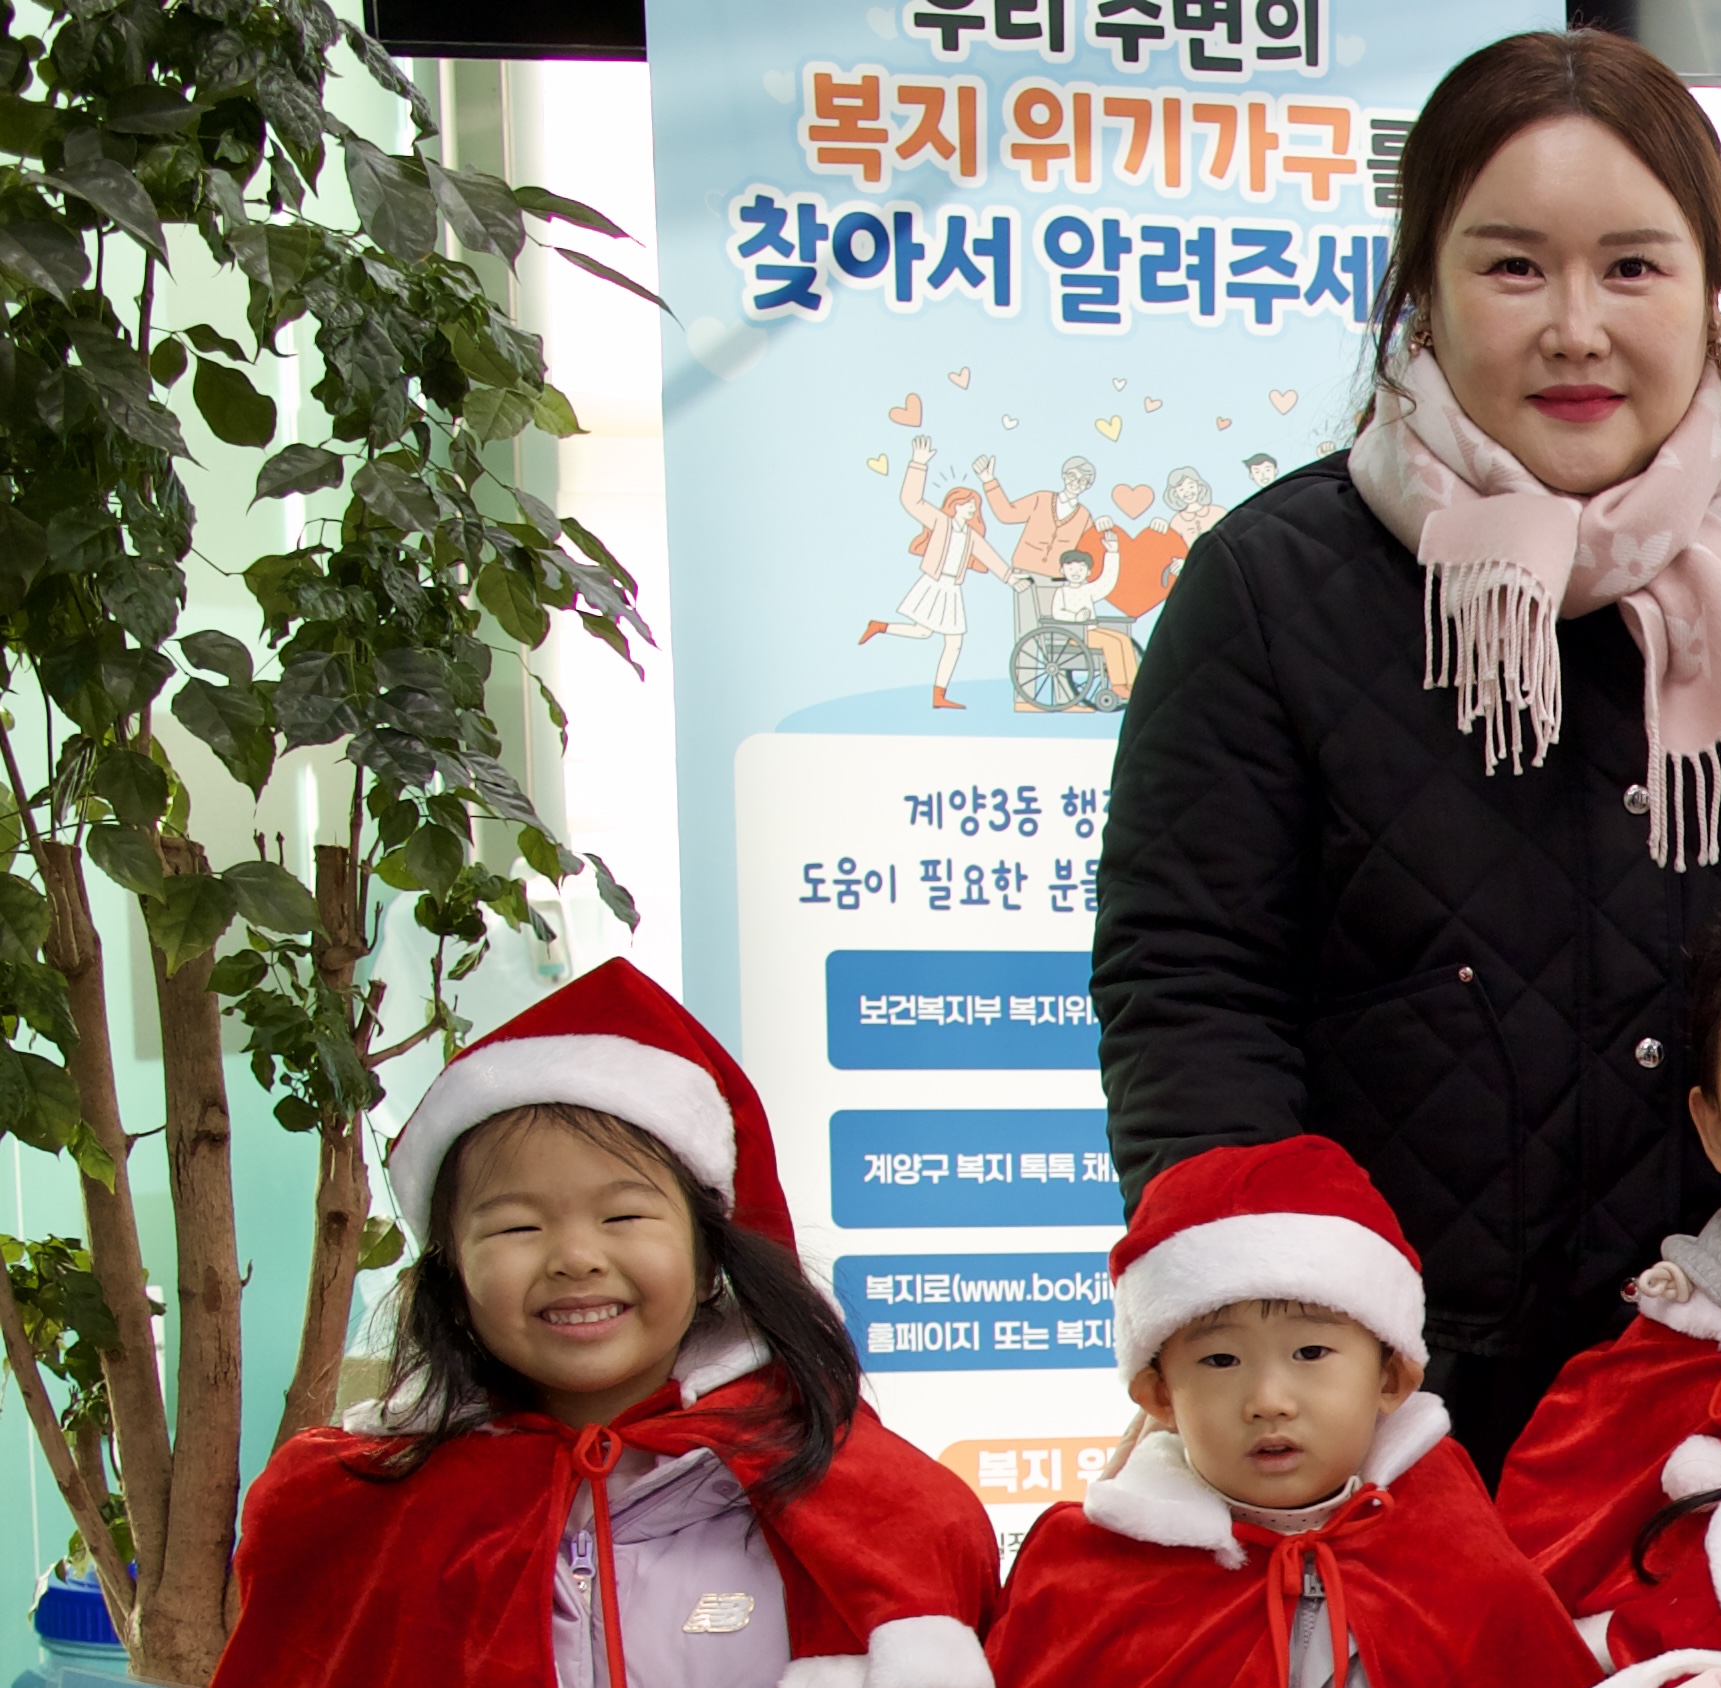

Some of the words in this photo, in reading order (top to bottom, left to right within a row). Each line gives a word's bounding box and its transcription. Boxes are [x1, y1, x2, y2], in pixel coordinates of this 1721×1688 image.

[912, 0, 1066, 54] 우리
[1094, 0, 1320, 72] 주변의
[808, 72, 979, 183] 복지
[736, 196, 1012, 312] 찾아서
[1042, 214, 1396, 326] 알려주세
[903, 785, 1043, 837] 계양3동
[799, 857, 896, 910] 도움이
[919, 858, 1028, 911] 필요한
[859, 995, 1001, 1025] 보건복지부
[1009, 995, 1101, 1025] 복지위
[863, 1153, 950, 1184] 계양구
[956, 1153, 1013, 1183] 복지
[1020, 1153, 1076, 1183] 톡톡
[867, 1321, 981, 1354] 홈페이지
[994, 1320, 1049, 1351] 또는
[978, 1448, 1062, 1493] 복지
